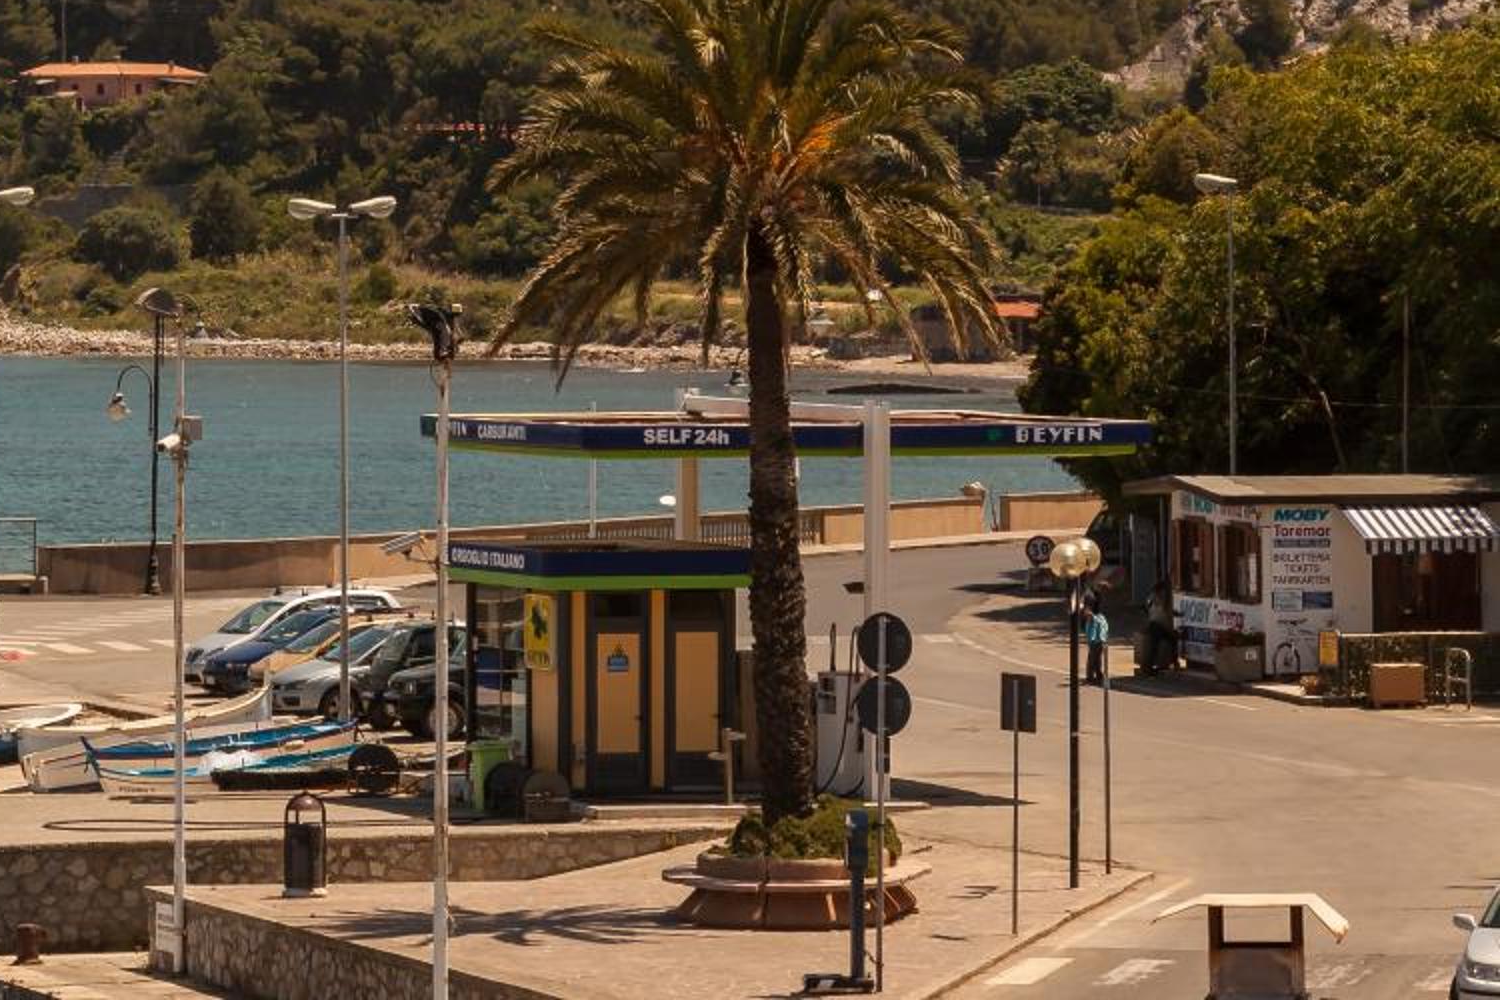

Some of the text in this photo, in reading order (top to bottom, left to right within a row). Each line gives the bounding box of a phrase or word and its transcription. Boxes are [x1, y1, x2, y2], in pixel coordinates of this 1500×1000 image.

[643, 428, 730, 445] SELF 24h
[1015, 426, 1103, 443] BEYFIN
[1273, 509, 1330, 521] MOBY
[1274, 524, 1332, 537] Toremar
